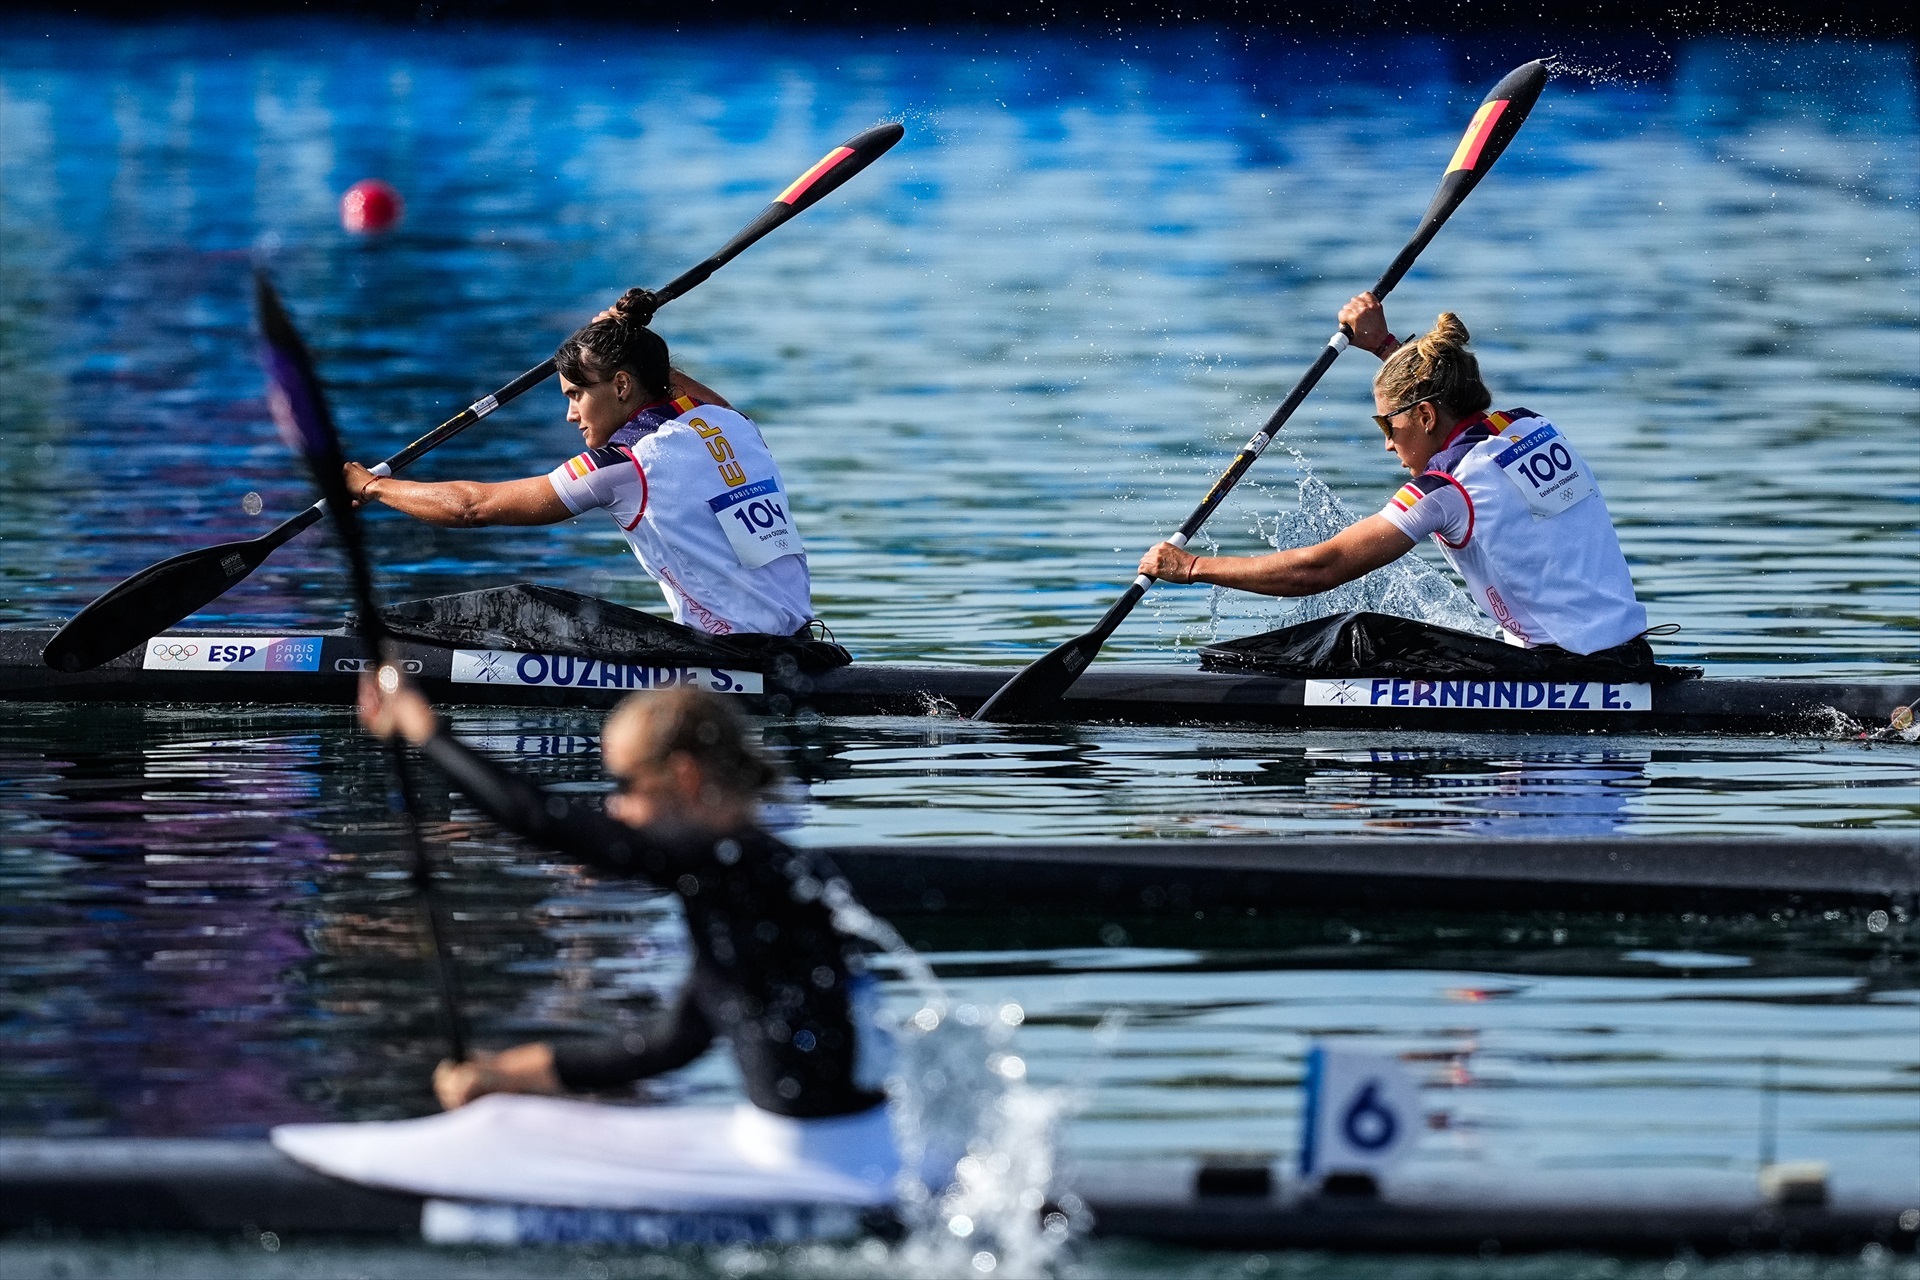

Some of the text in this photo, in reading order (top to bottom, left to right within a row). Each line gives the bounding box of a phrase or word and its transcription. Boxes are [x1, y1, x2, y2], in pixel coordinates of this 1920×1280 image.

[689, 418, 746, 488] ESP
[1513, 440, 1534, 455] PARIS
[1517, 442, 1572, 489] 100
[729, 488, 750, 502] PARIS
[733, 499, 788, 536] 104
[759, 531, 774, 543] Sara
[208, 645, 256, 663] ESP
[275, 644, 314, 653] PARIS
[275, 653, 313, 663] 2024
[516, 653, 743, 692] OUZANDE S.
[1370, 679, 1632, 710] FERNANDEZ E.
[1342, 1080, 1397, 1152] 6
